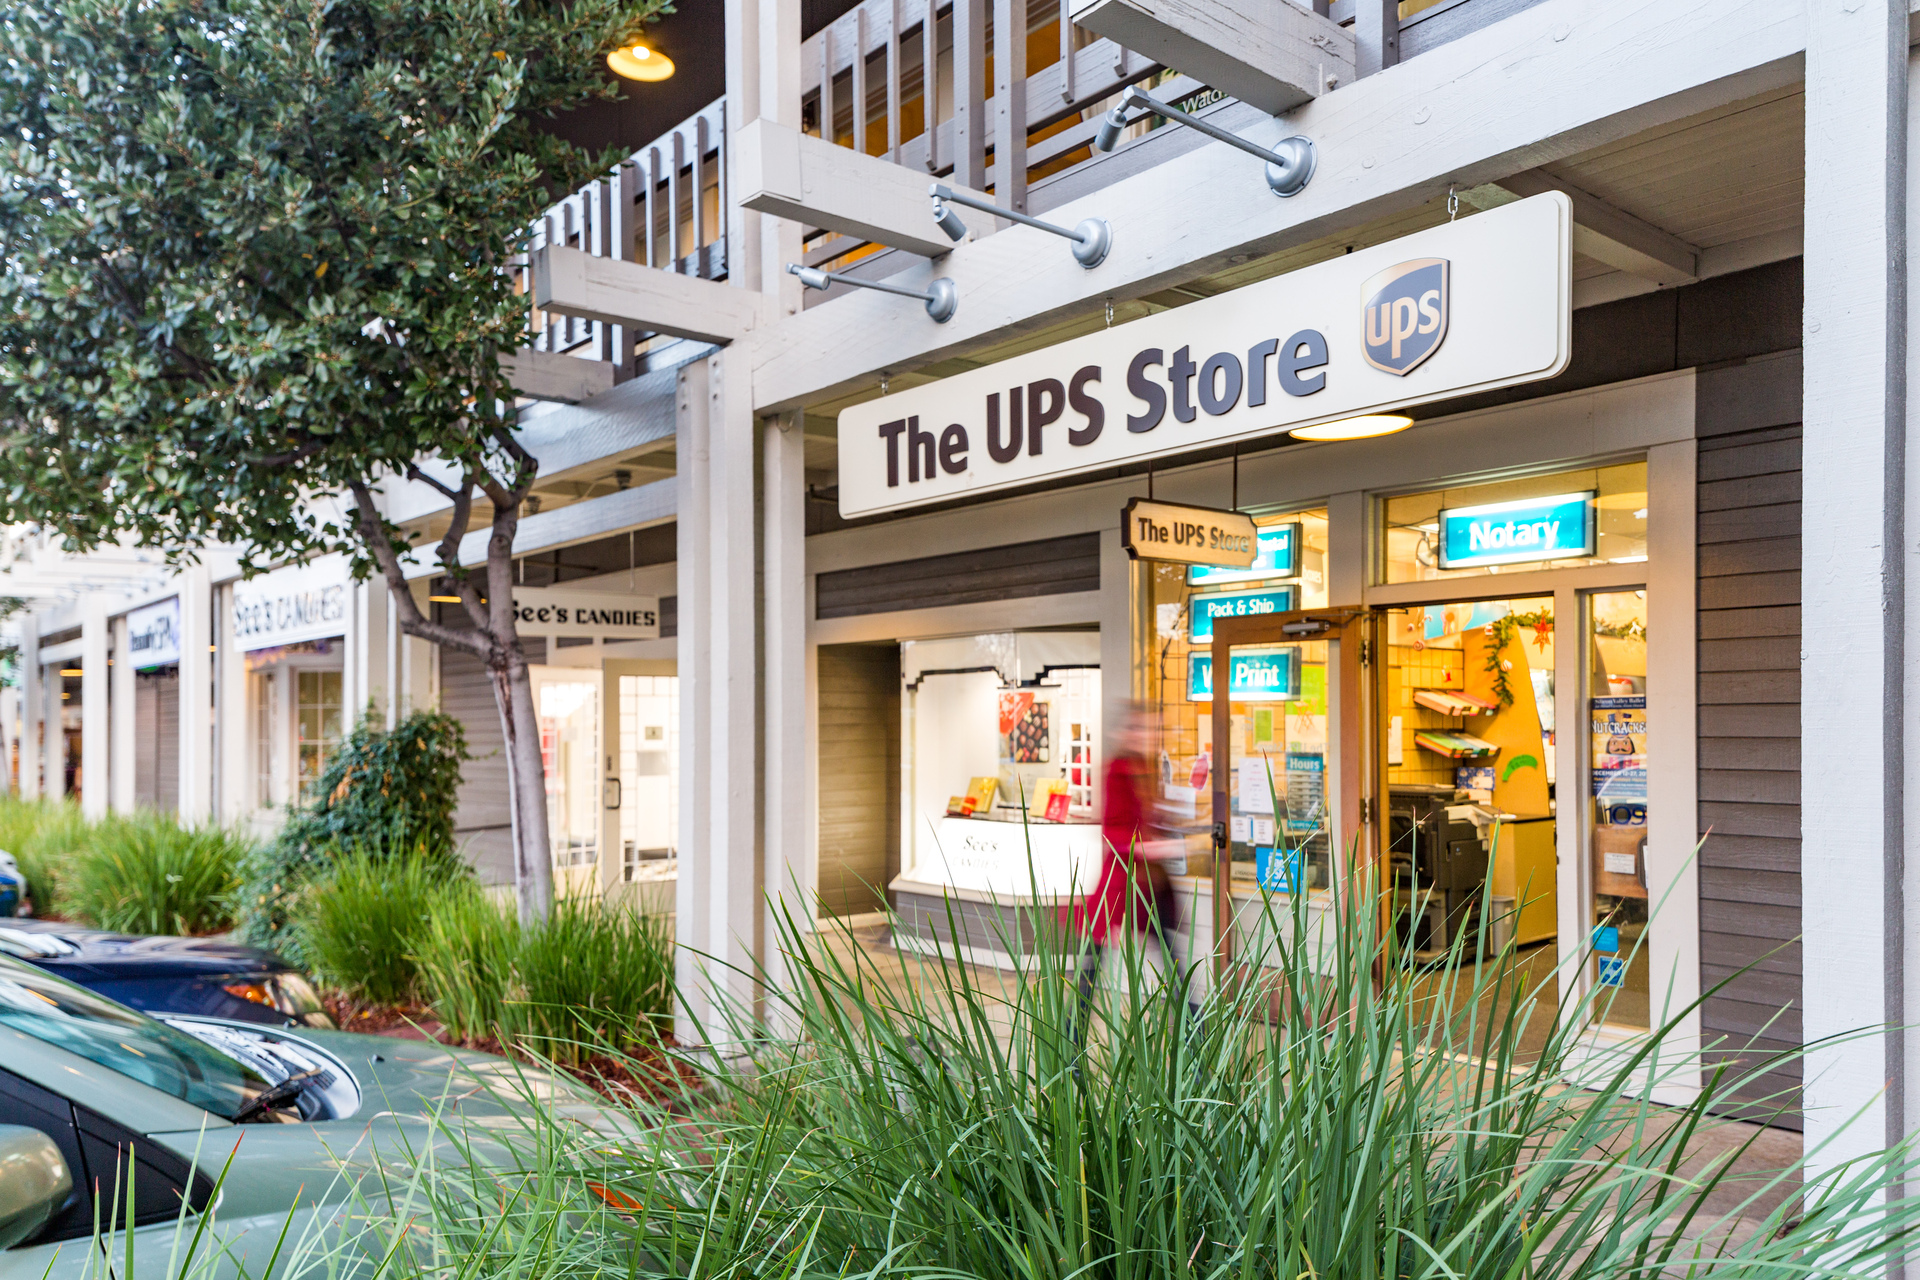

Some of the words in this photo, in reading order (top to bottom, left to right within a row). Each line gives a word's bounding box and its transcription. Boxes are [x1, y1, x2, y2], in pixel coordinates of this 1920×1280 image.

[1366, 288, 1441, 360] ups
[879, 414, 969, 487] The
[986, 364, 1105, 464] UPS
[1126, 328, 1330, 434] Store
[1137, 516, 1169, 544] The
[1174, 521, 1205, 548] UPS
[1209, 526, 1250, 553] Store
[1469, 519, 1560, 551] Notary
[576, 608, 656, 627] CANDIES
[1207, 601, 1234, 618] Pack
[1236, 600, 1246, 616] &
[1248, 597, 1275, 614] Ship
[1235, 662, 1280, 688] Print
[1592, 720, 1647, 734] NUTCRACKE
[1290, 758, 1320, 770] Hours
